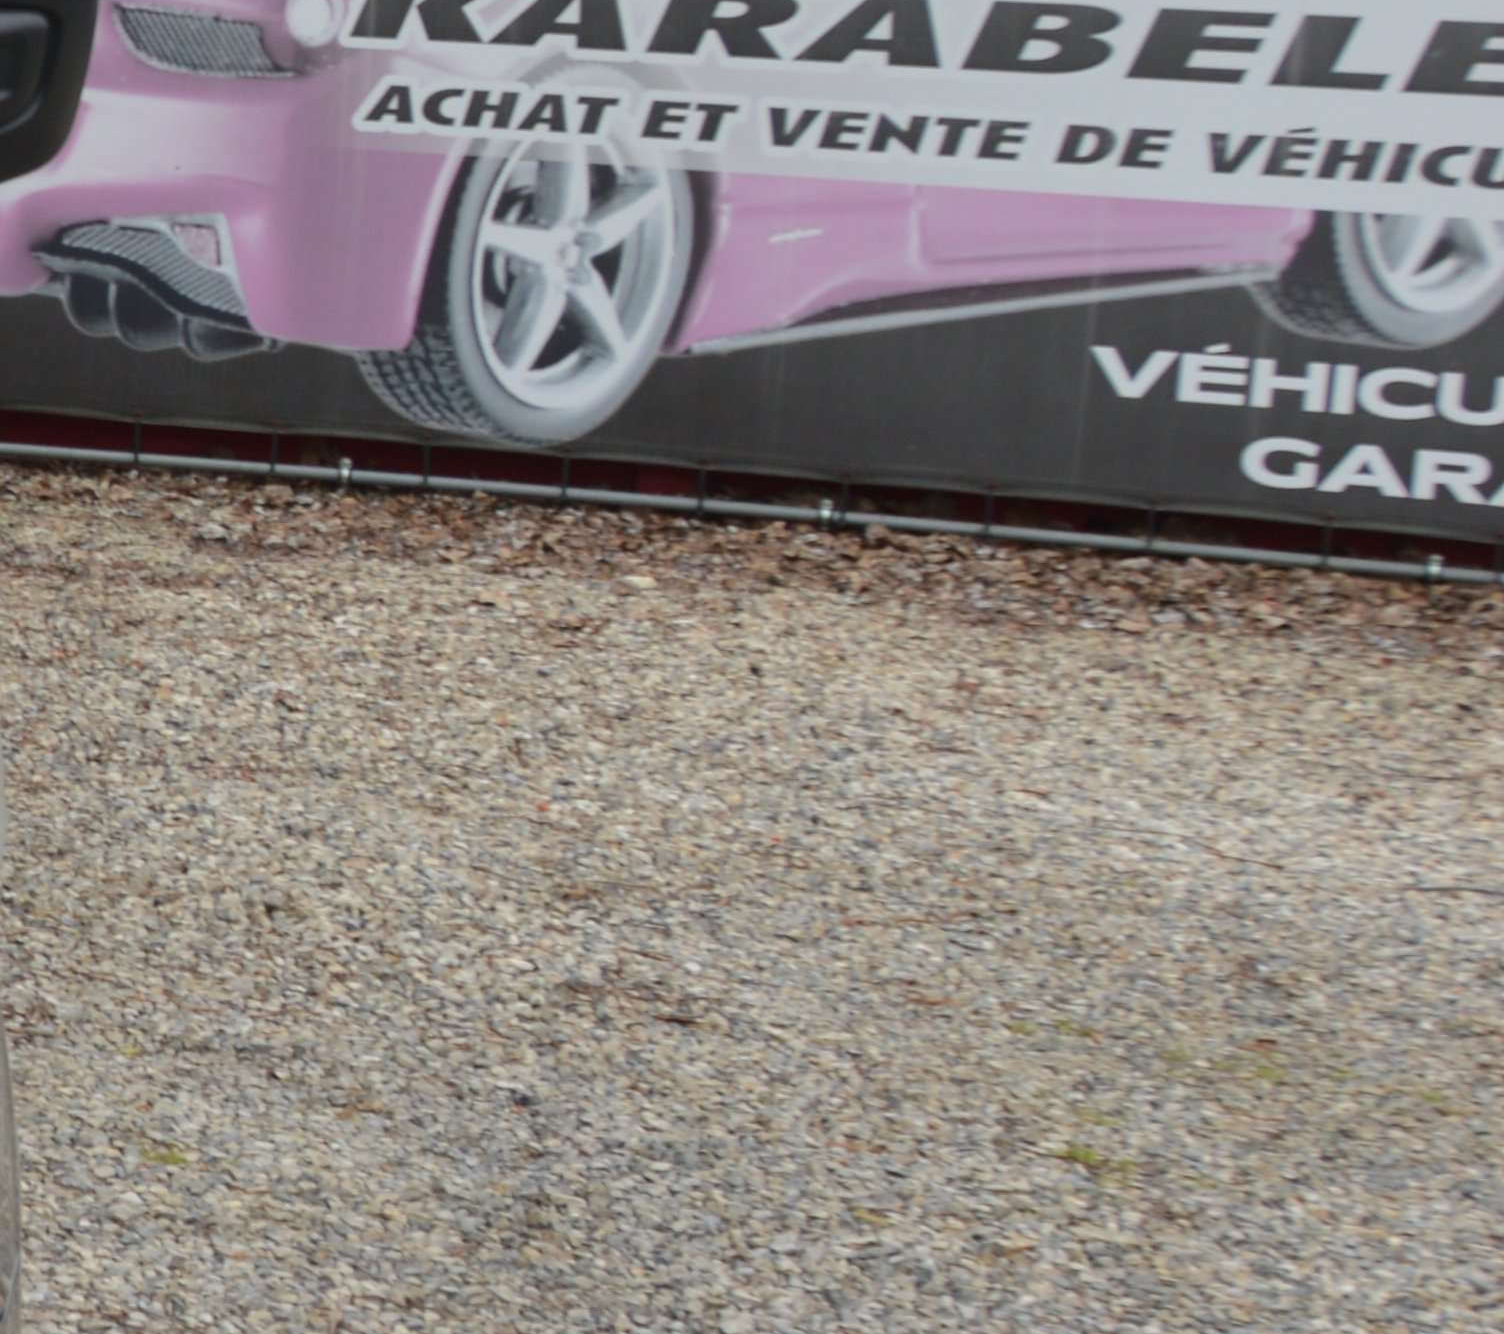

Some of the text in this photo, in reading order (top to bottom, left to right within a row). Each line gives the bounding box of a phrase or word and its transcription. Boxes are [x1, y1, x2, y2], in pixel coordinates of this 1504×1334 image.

[364, 85, 618, 134] ACHAT
[641, 100, 738, 142] ET
[768, 107, 1029, 161] VENTE
[1055, 124, 1173, 168] DE
[1091, 343, 1504, 426] VÉHICU
[1241, 435, 1504, 507] GAR
